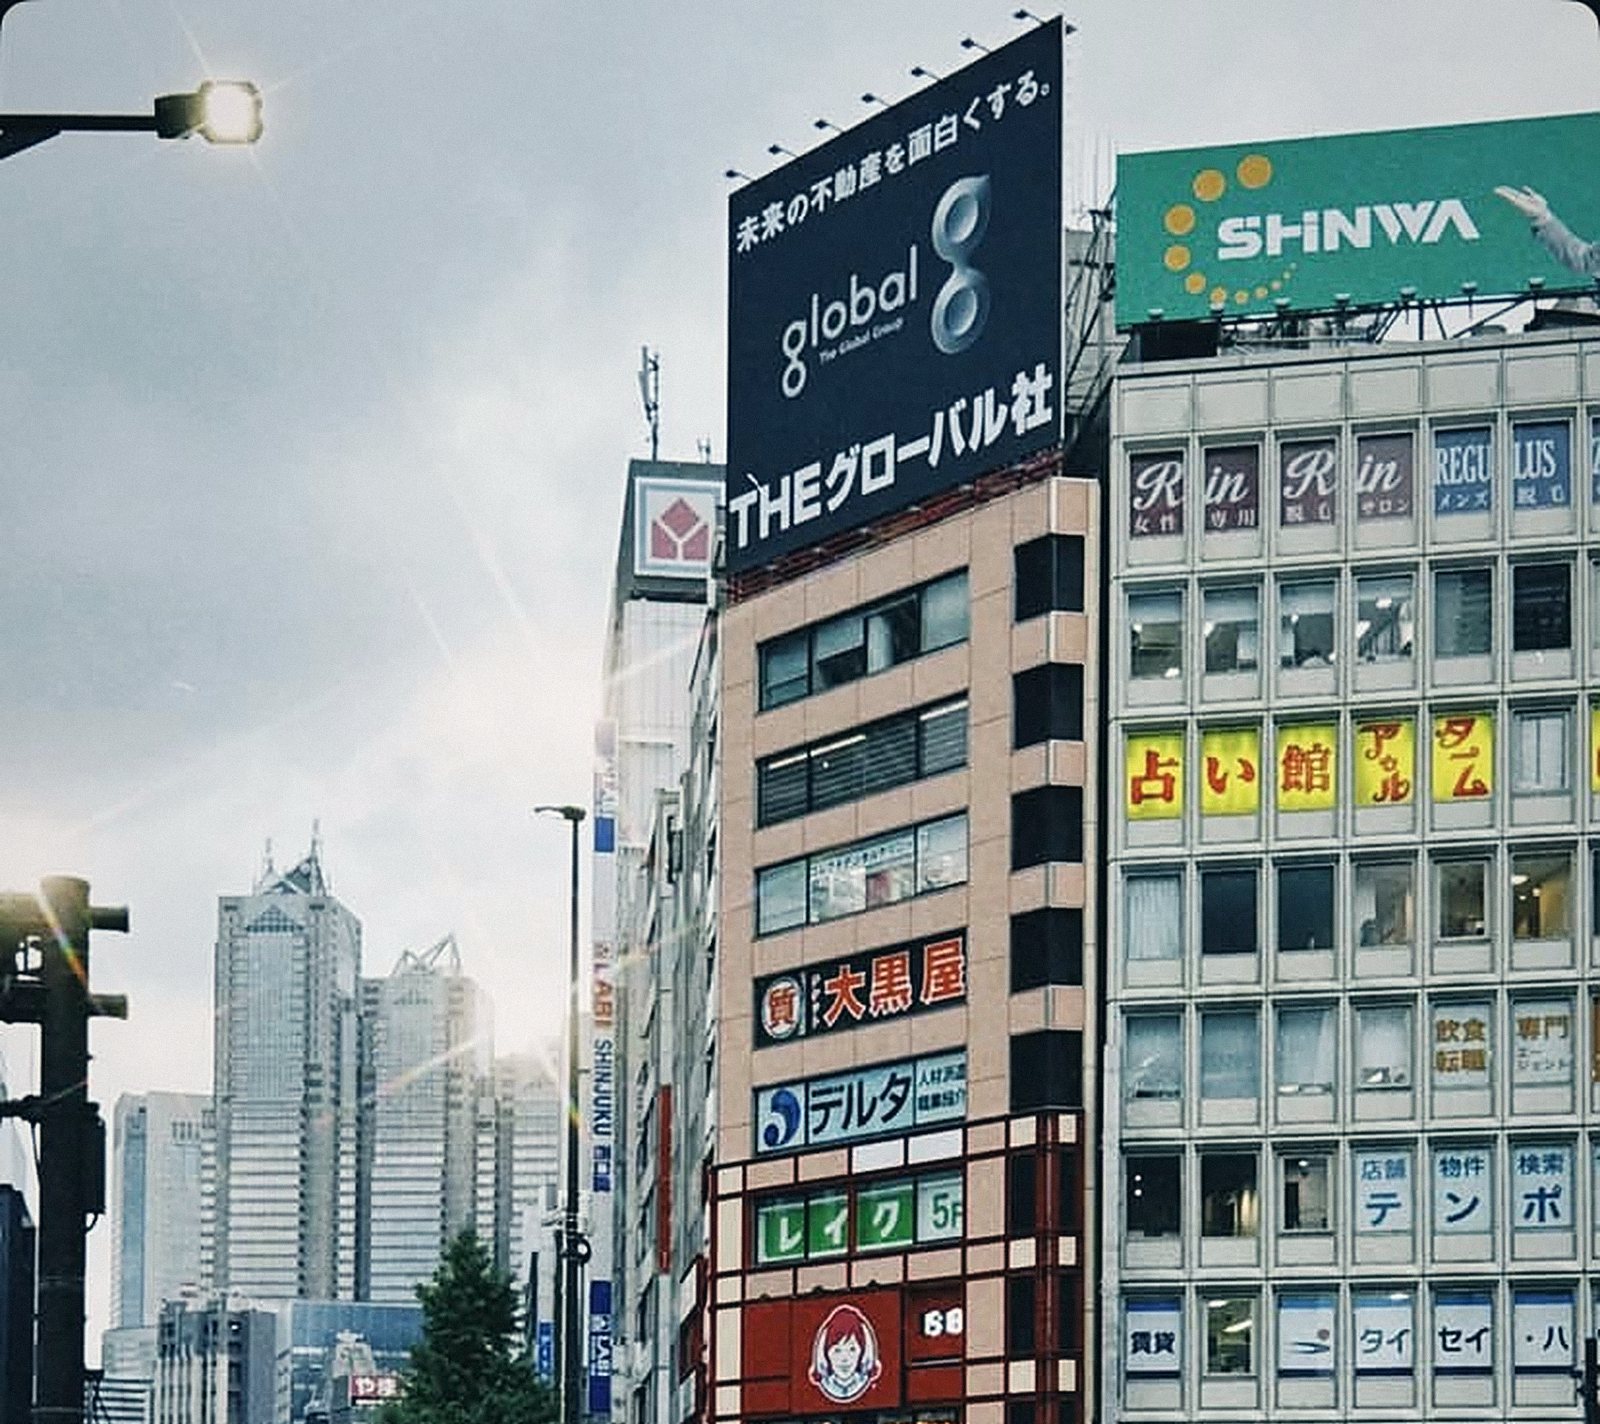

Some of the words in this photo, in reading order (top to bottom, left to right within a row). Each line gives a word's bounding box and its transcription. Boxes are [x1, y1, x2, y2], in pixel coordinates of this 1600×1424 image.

[736, 69, 1051, 254] 未来の不動産を面白くする。
[781, 243, 919, 399] global
[730, 361, 1053, 549] THEグローバル社
[1130, 750, 1333, 805] 占い館
[822, 936, 966, 1028] 大黒屋
[593, 1038, 615, 1137] SHINJUKU
[810, 1071, 912, 1136] デルタ
[779, 1200, 901, 1252] レイク
